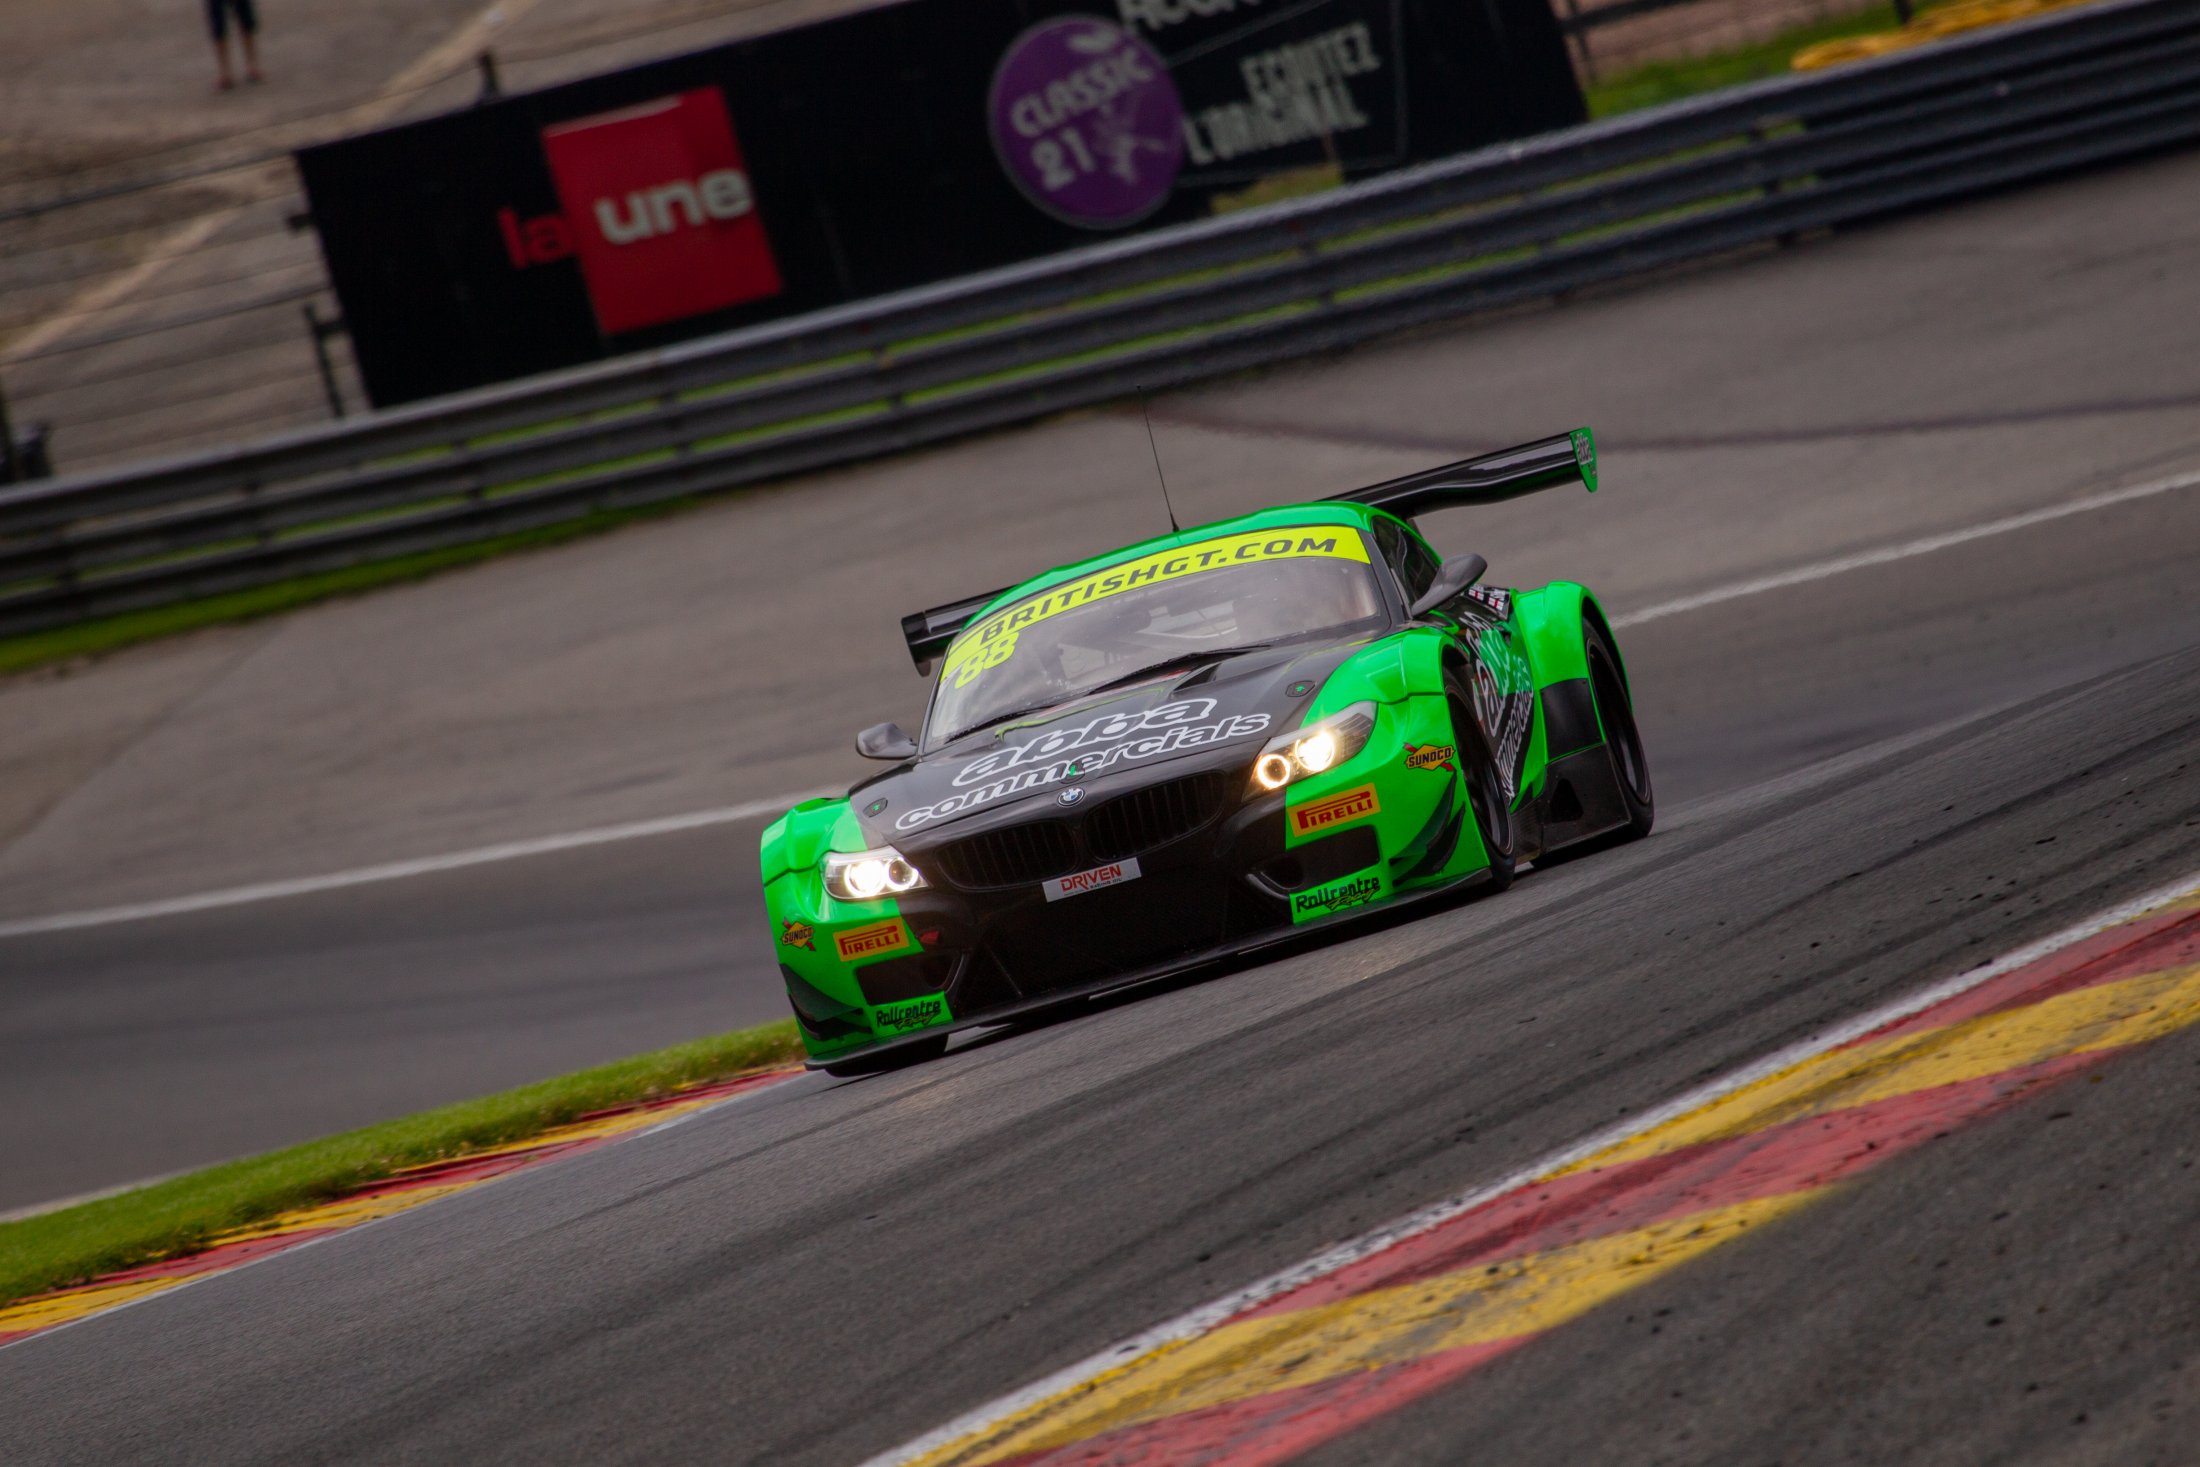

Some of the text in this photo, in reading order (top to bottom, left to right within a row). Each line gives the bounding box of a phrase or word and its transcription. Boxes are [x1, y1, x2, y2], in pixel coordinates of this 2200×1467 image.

[1010, 47, 1155, 138] CLASSIC
[1030, 127, 1095, 192] 21
[497, 167, 754, 270] la une
[979, 536, 1338, 645] BRITISHGT.COM
[954, 630, 1020, 689] 88
[951, 697, 1218, 787] abba
[1408, 746, 1452, 768] SUNOCO
[895, 712, 1271, 831] commercials
[1296, 790, 1373, 830] PIRELLI
[1060, 863, 1122, 892] DRIVEN
[1296, 877, 1380, 913] Rollcentre
[783, 926, 814, 945] SUNOCO
[838, 925, 901, 956] PIRELLI
[876, 1000, 941, 1028] Rollcentre
